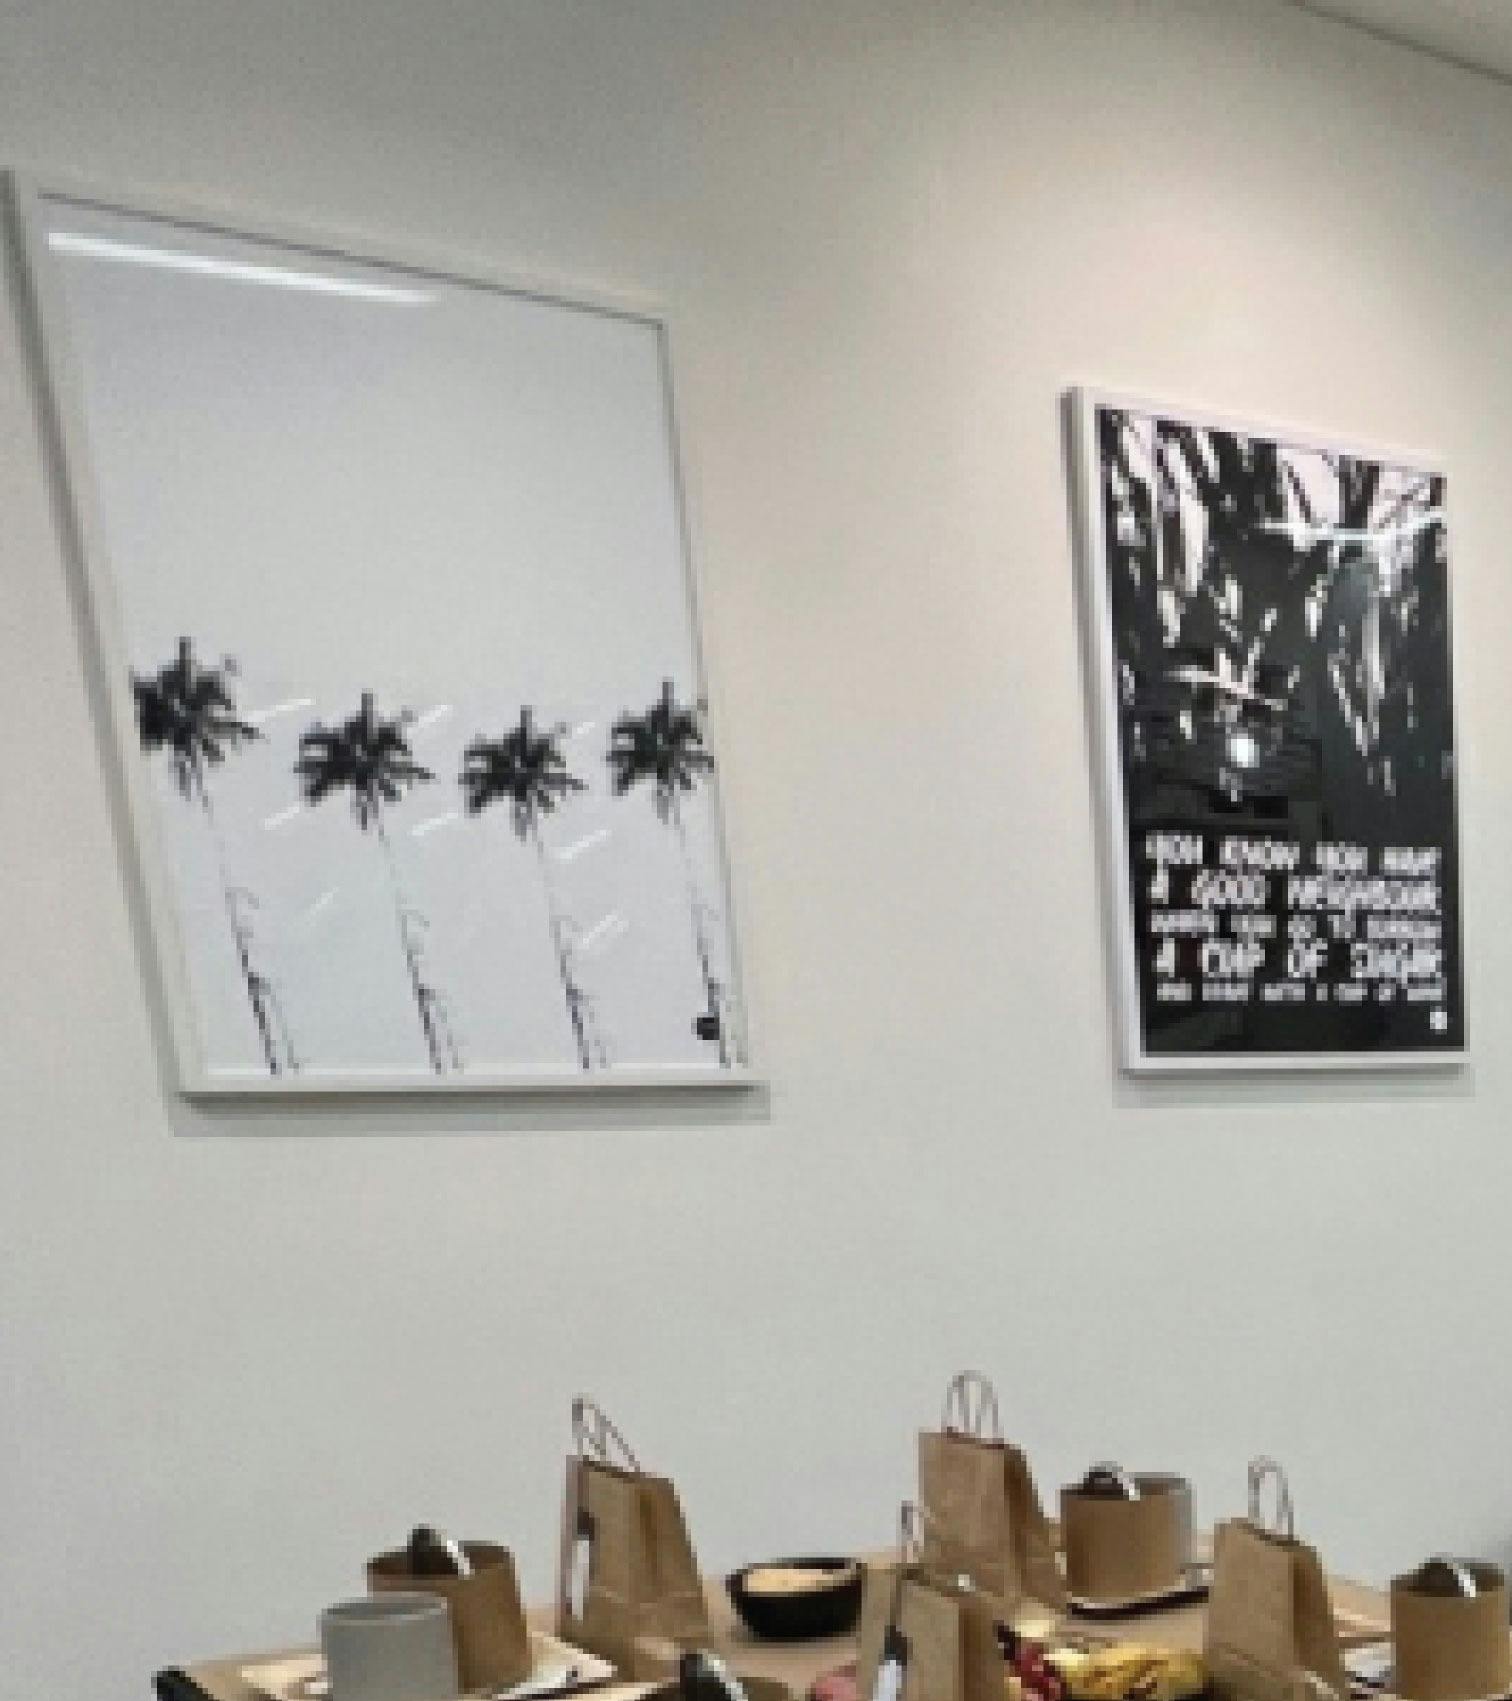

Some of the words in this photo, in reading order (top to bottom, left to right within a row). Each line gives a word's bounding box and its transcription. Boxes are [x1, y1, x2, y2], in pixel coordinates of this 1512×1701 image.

[1146, 830, 1203, 866] YOU
[1219, 835, 1301, 869] KNOW
[1316, 841, 1368, 871] YOU
[1150, 866, 1170, 905] A
[1191, 868, 1267, 909] GOOD
[1230, 914, 1277, 938] YOU
[1327, 911, 1356, 939] TO
[1156, 938, 1176, 978] A
[1197, 938, 1266, 978] CUP
[1288, 938, 1329, 978] OF
[1349, 942, 1443, 981] SUGAR
